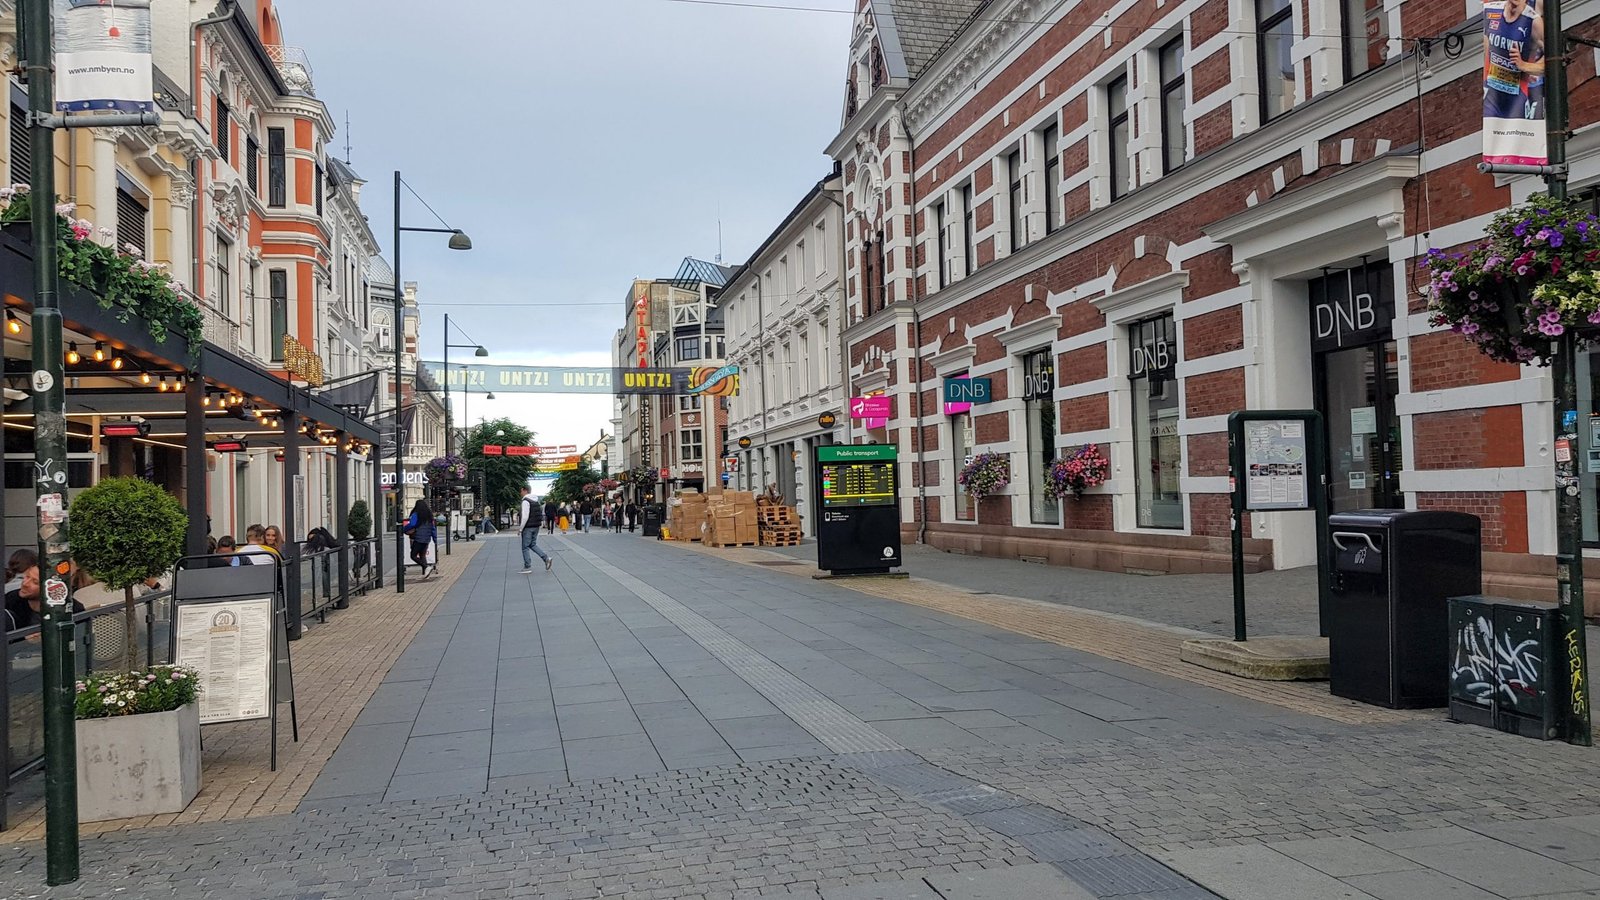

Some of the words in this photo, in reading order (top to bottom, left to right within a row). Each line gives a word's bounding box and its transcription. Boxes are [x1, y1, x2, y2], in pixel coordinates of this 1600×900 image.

[68, 65, 135, 75] www.nmbyen.no
[1316, 269, 1375, 347] DNB
[1133, 321, 1169, 382] DNB
[435, 369, 485, 385] UNTZ!
[499, 371, 549, 386] UNTZ!
[563, 372, 611, 387] UNTZ!
[624, 373, 671, 388] UNTZ!
[1025, 354, 1050, 403] DNB
[950, 379, 985, 402] DNB
[640, 399, 650, 462] McDonald's
[820, 415, 834, 423] nille
[218, 614, 230, 625] 20
